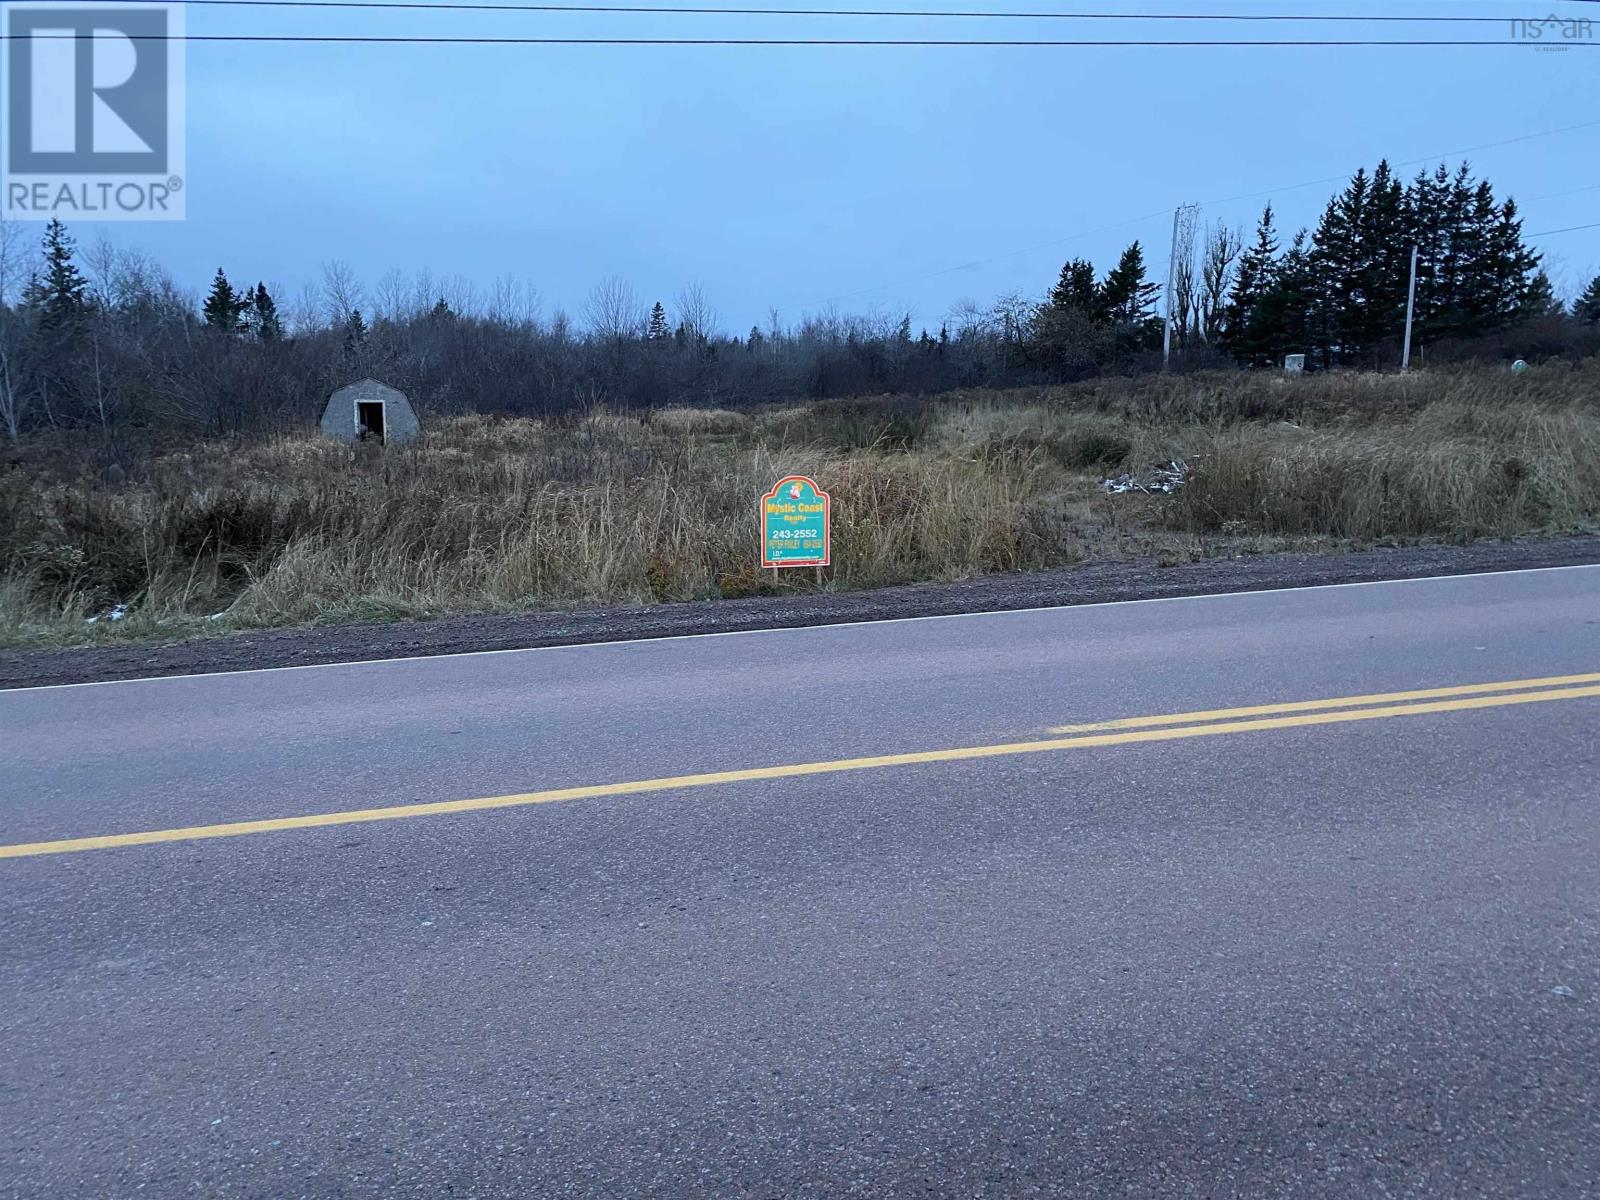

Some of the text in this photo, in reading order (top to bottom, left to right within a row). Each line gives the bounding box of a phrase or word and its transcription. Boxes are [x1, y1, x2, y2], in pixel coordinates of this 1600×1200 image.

[767, 503, 824, 515] Mystic Coast
[772, 529, 818, 539] 243-2552
